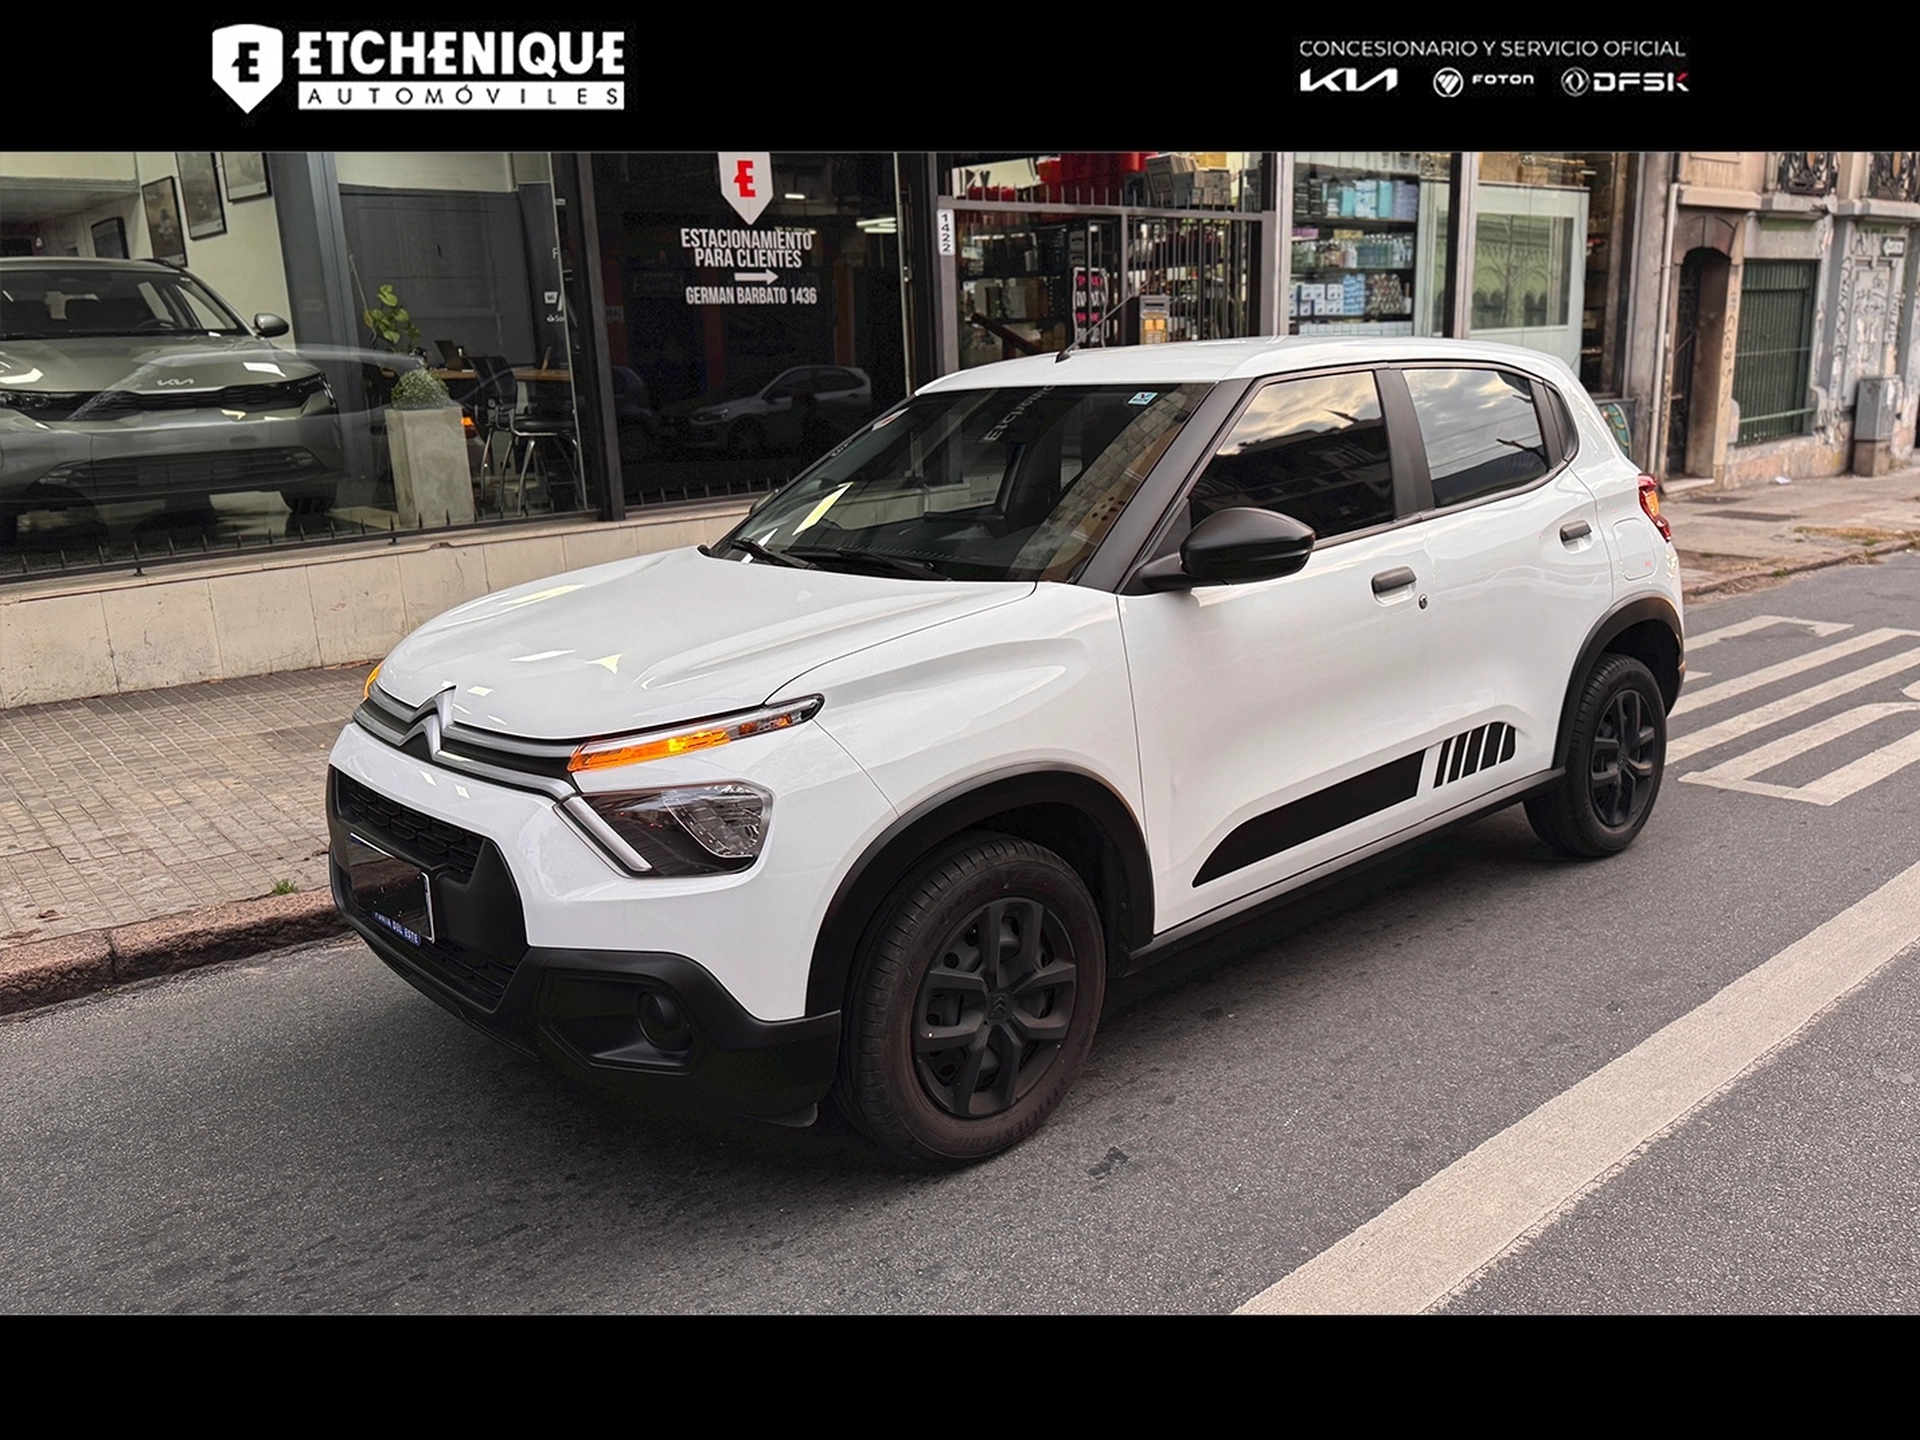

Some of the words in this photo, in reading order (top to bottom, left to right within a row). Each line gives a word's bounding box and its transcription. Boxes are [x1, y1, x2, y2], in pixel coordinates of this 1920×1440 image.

[680, 228, 813, 250] ESTACIONAMIENTO
[941, 213, 951, 252] 1422
[694, 248, 735, 268] PARA
[736, 249, 803, 269] CLIENTES
[685, 286, 735, 305] GERMAN
[736, 286, 788, 305] BARBATO
[790, 287, 818, 305] 1436
